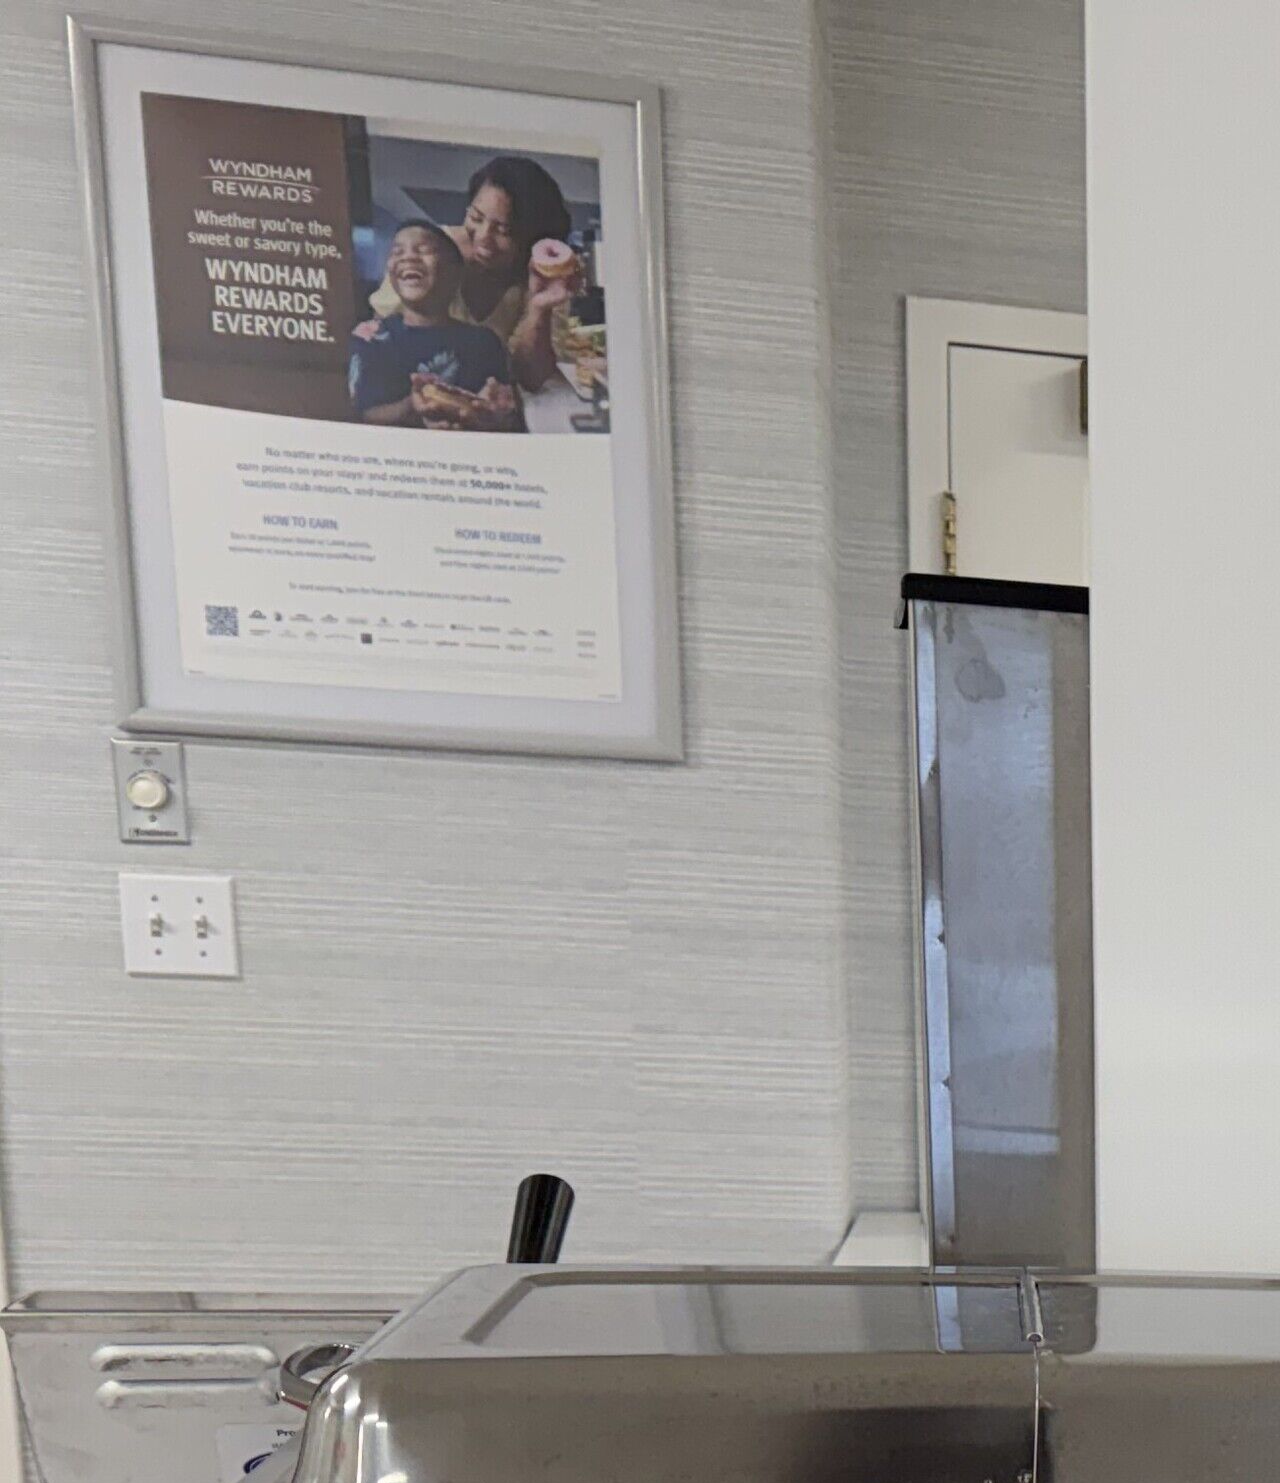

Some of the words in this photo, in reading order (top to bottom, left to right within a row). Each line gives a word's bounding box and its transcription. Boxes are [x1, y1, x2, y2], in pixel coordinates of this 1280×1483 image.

[208, 158, 312, 183] WYNDHAM
[212, 180, 313, 203] REWARDS
[194, 209, 257, 230] Whether
[260, 217, 304, 235] you're
[308, 220, 333, 237] the
[187, 231, 231, 247] sweet
[234, 235, 249, 249] or
[253, 237, 300, 257] savory
[205, 257, 328, 290] WYNDHAM
[215, 284, 324, 316] REWARDS
[211, 310, 336, 343] EVERYONE.
[263, 514, 289, 527] HOW
[292, 515, 306, 528] TO
[309, 517, 338, 530] EARN
[484, 530, 497, 541] TO
